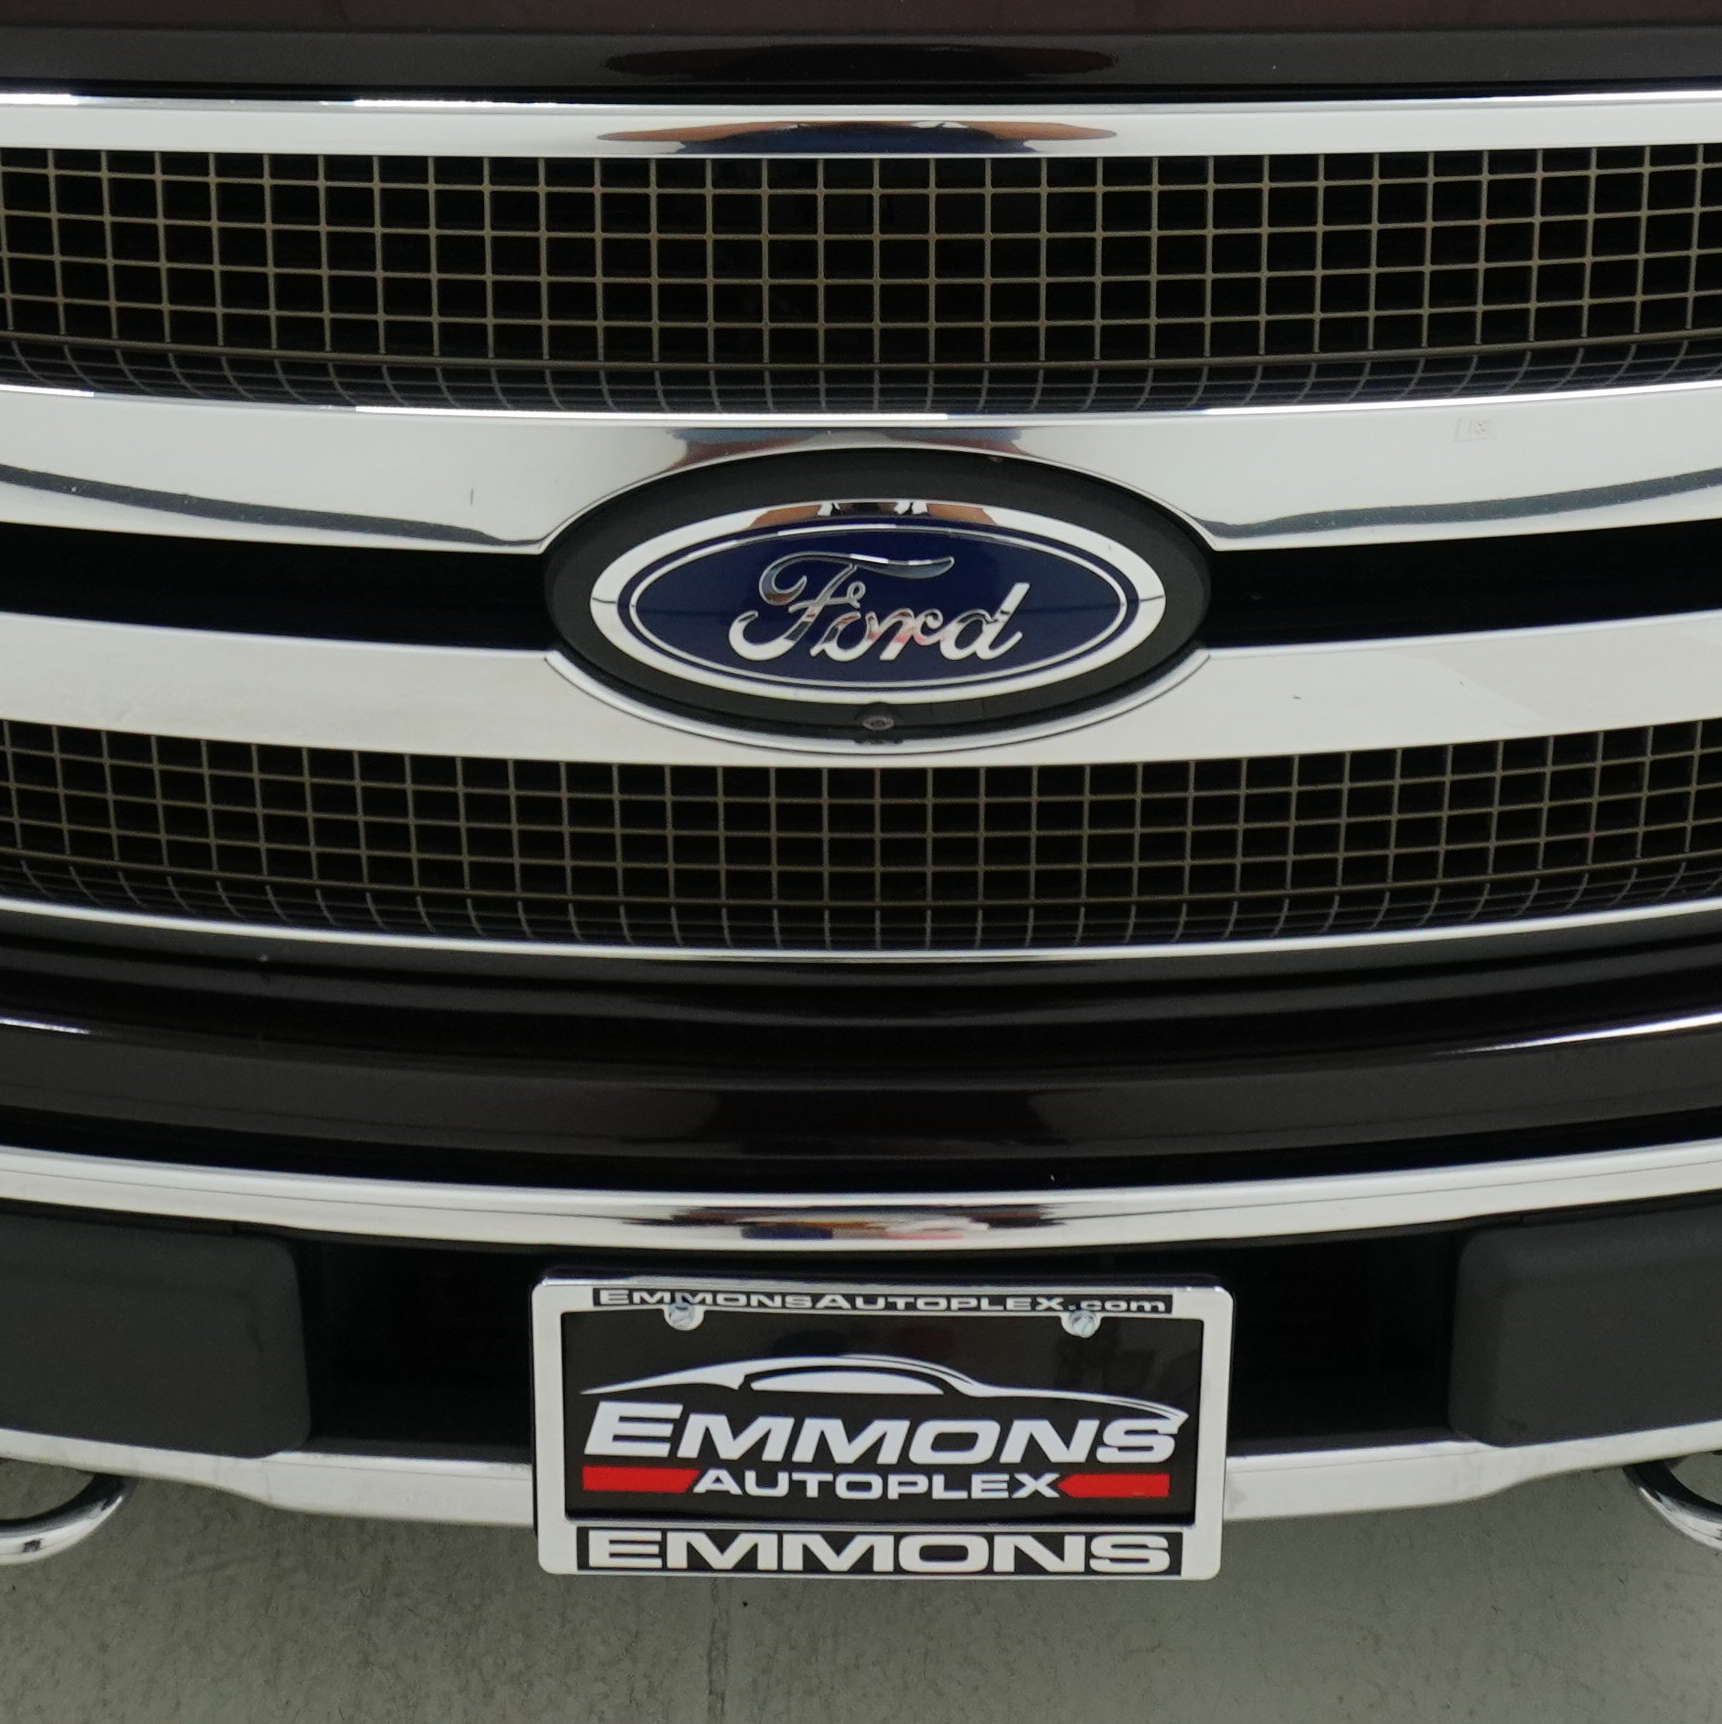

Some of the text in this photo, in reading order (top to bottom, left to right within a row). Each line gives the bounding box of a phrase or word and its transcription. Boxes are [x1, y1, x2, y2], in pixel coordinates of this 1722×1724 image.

[728, 550, 1031, 662] Ford
[583, 1401, 1176, 1465] EMMONS
[693, 1469, 1061, 1500] AUTOPLEX
[588, 1531, 1171, 1573] EMMONS
